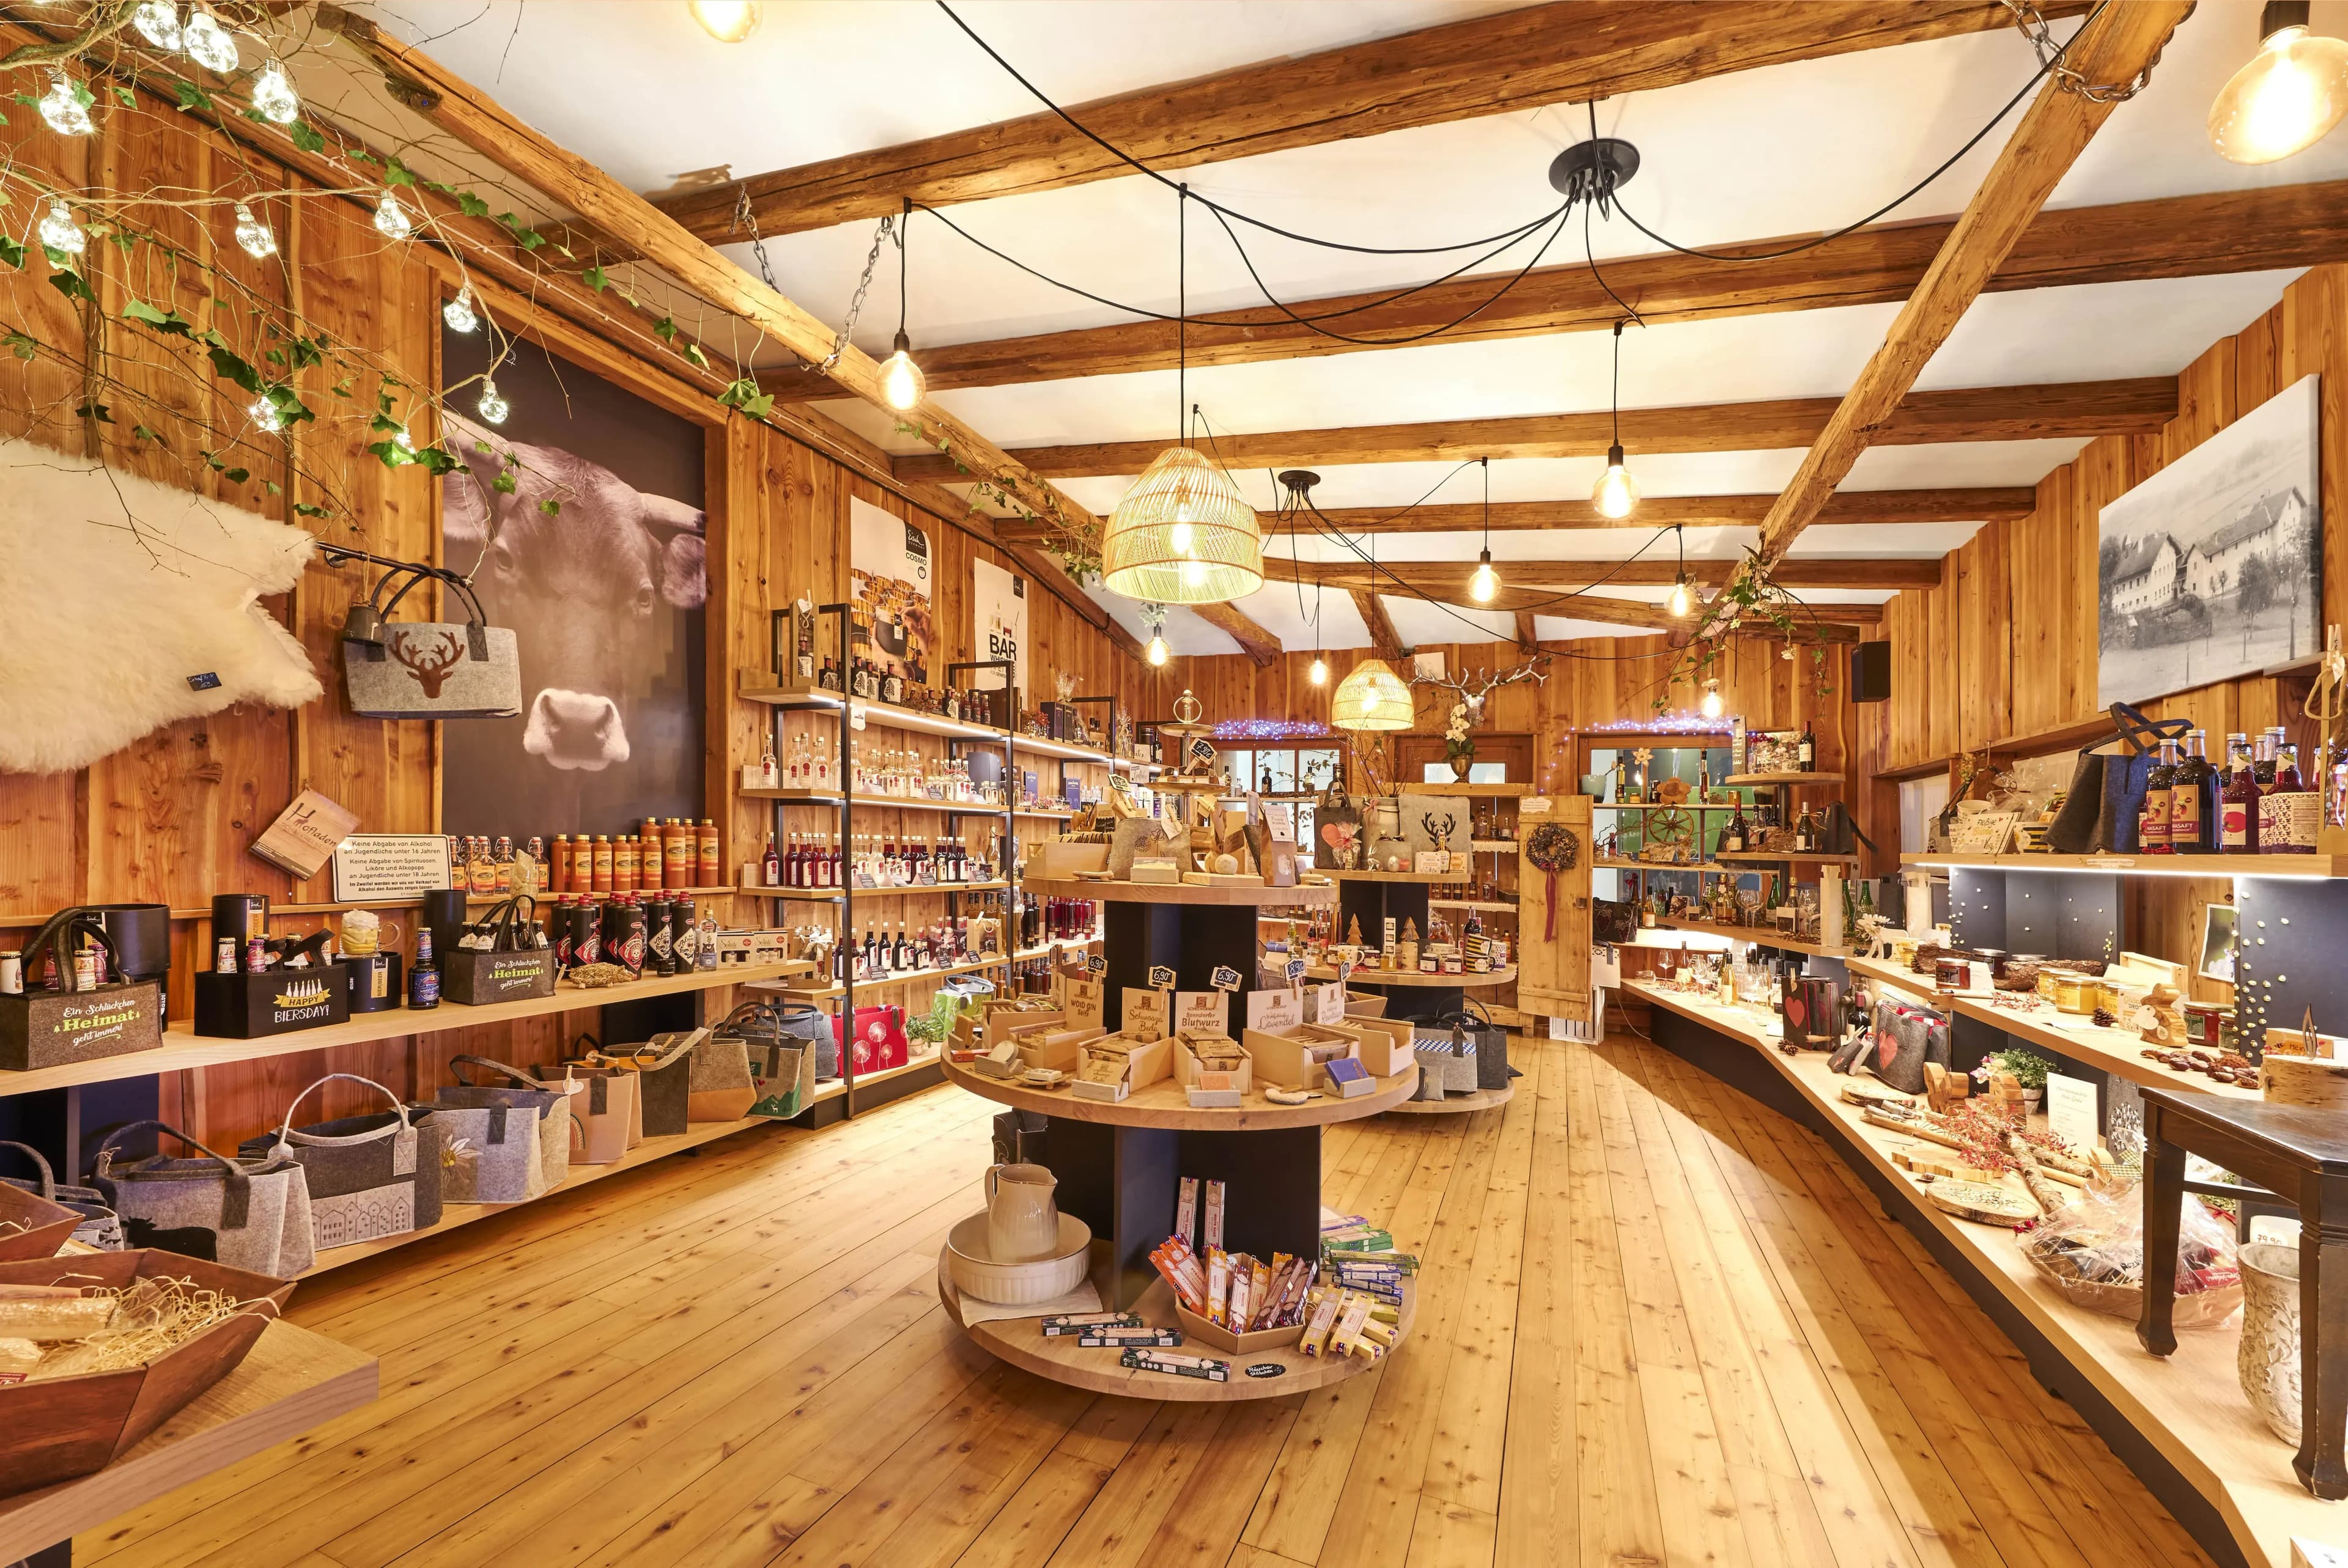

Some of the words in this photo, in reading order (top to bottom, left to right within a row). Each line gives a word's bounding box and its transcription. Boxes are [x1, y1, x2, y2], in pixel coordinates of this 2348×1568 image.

[908, 529, 925, 546] Eisch
[906, 552, 927, 566] COSMO
[989, 633, 1017, 661] BAR
[286, 803, 336, 847] Hofladen
[508, 959, 541, 968] Schlückchen
[494, 966, 540, 979] Heimat
[500, 979, 513, 990] geht
[514, 976, 533, 986] immer!
[289, 995, 319, 1006] HAPPY
[1071, 999, 1086, 1009] WOID
[63, 1007, 83, 1018] Ein
[86, 999, 136, 1015] Schlückchen
[275, 1004, 330, 1023] BIERSDAY!
[62, 1009, 136, 1032] Heimat
[1181, 1018, 1220, 1027] Blutwurz
[1257, 1014, 1295, 1030] Lavendel
[73, 1030, 94, 1047] geht
[94, 1022, 123, 1037] immer!
[1247, 1365, 1274, 1374] Räucher
